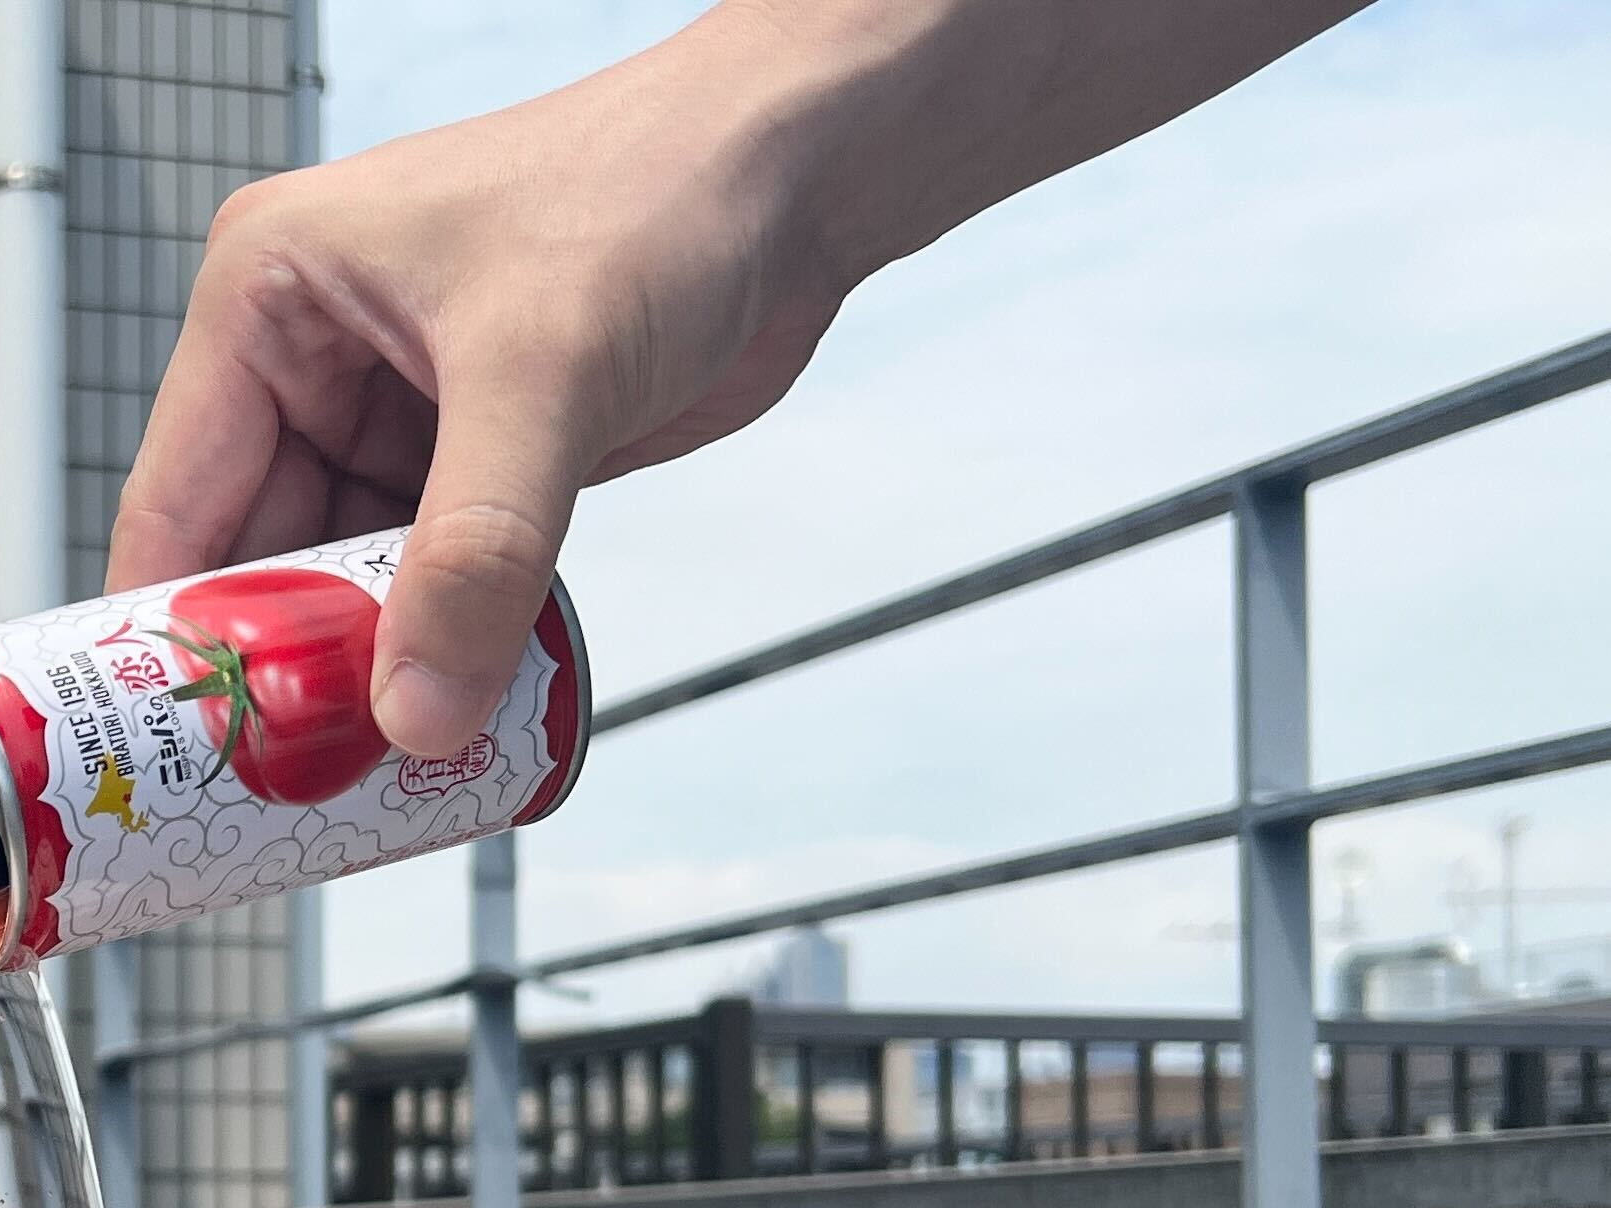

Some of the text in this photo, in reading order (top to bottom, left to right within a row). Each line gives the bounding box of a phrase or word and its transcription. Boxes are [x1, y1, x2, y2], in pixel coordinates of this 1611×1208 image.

[46, 665, 109, 776] SINCE 1986
[164, 693, 183, 732] LOVER
